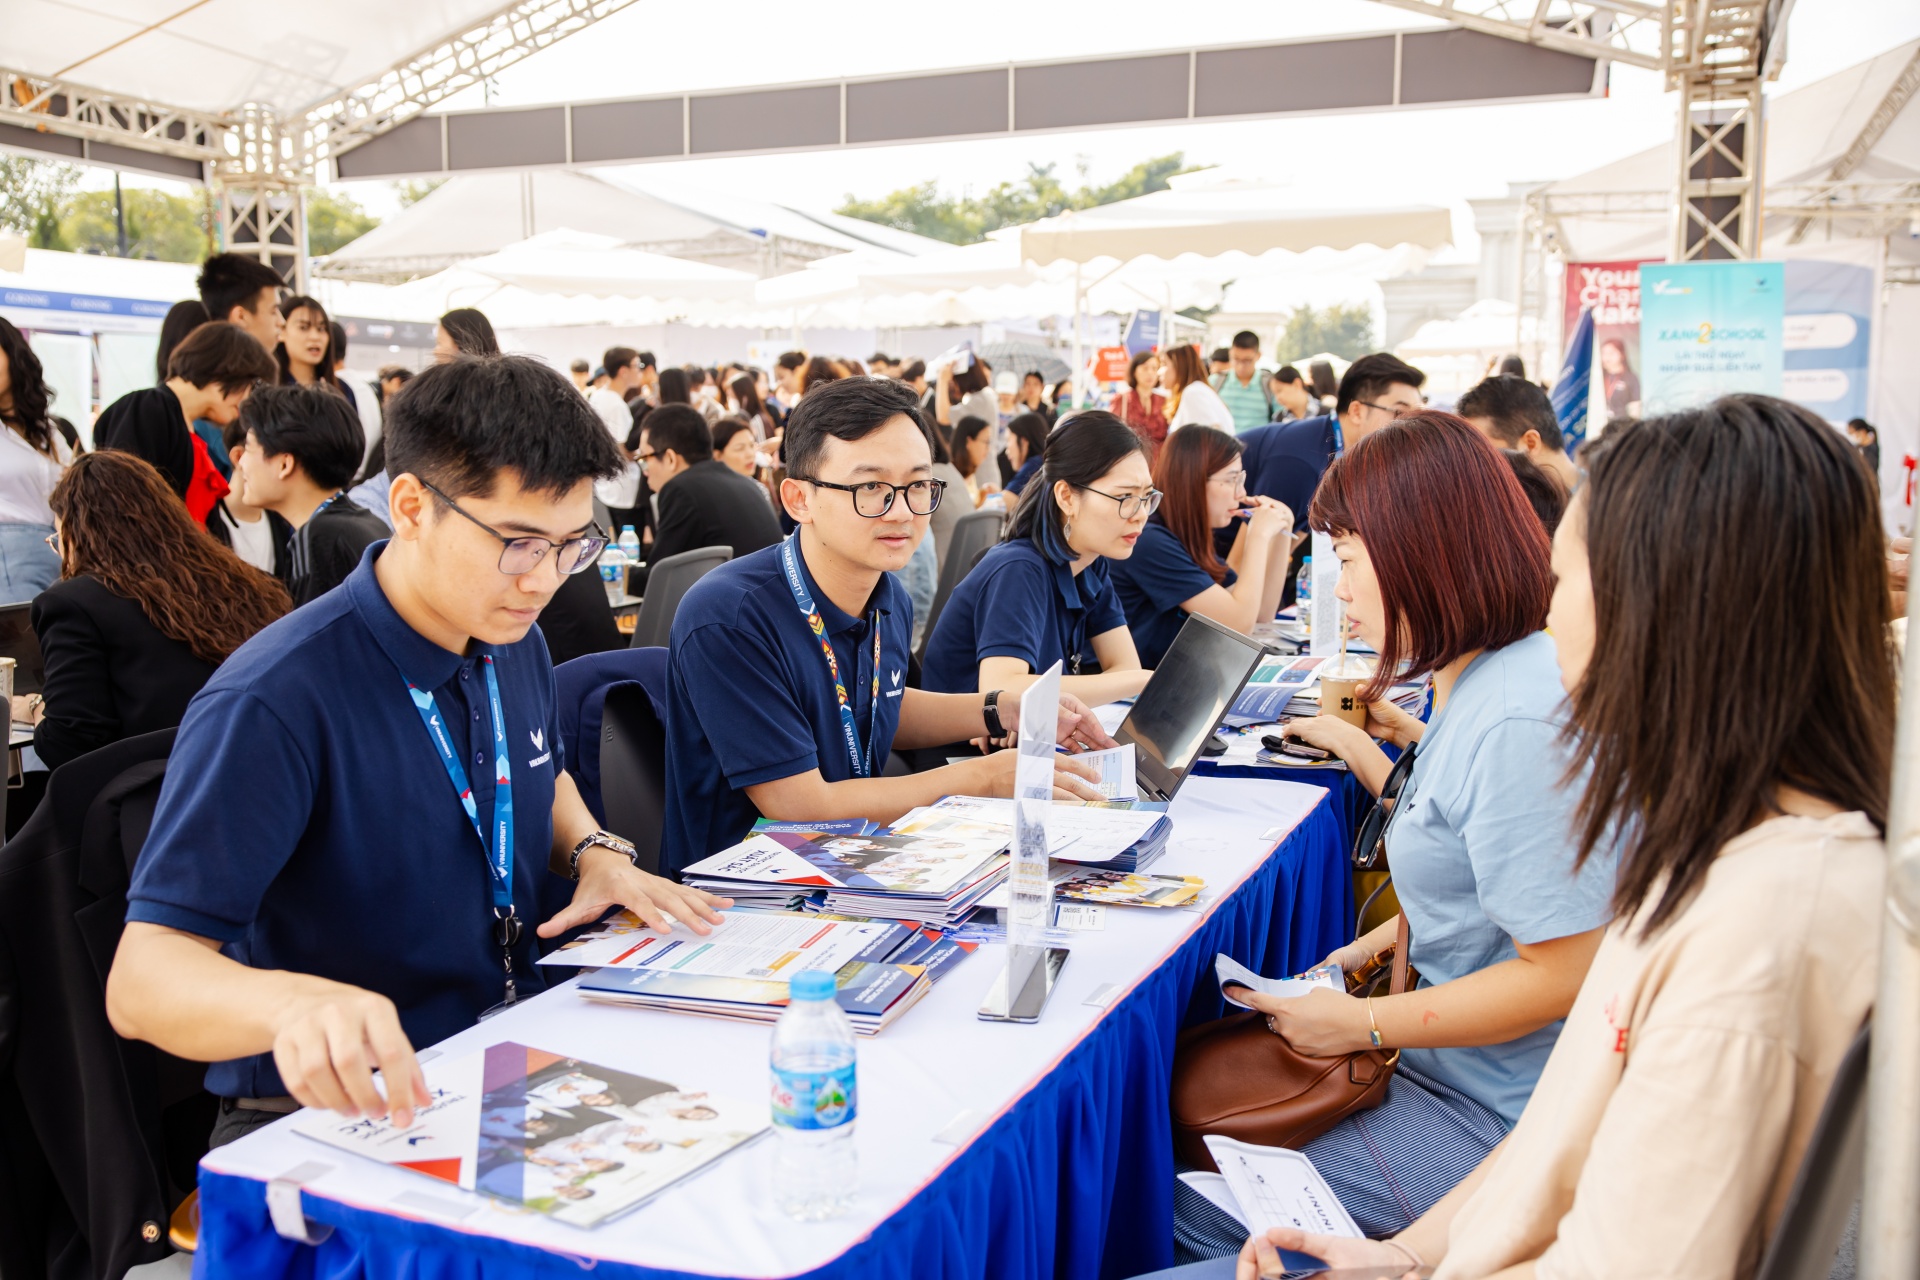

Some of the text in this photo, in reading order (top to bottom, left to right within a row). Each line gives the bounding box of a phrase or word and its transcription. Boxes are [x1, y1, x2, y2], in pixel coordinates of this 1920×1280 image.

[844, 722, 862, 775] VINUNIVERSITY
[499, 820, 507, 865] VINUNIVERSITY
[1303, 1186, 1334, 1231] VINUNI
